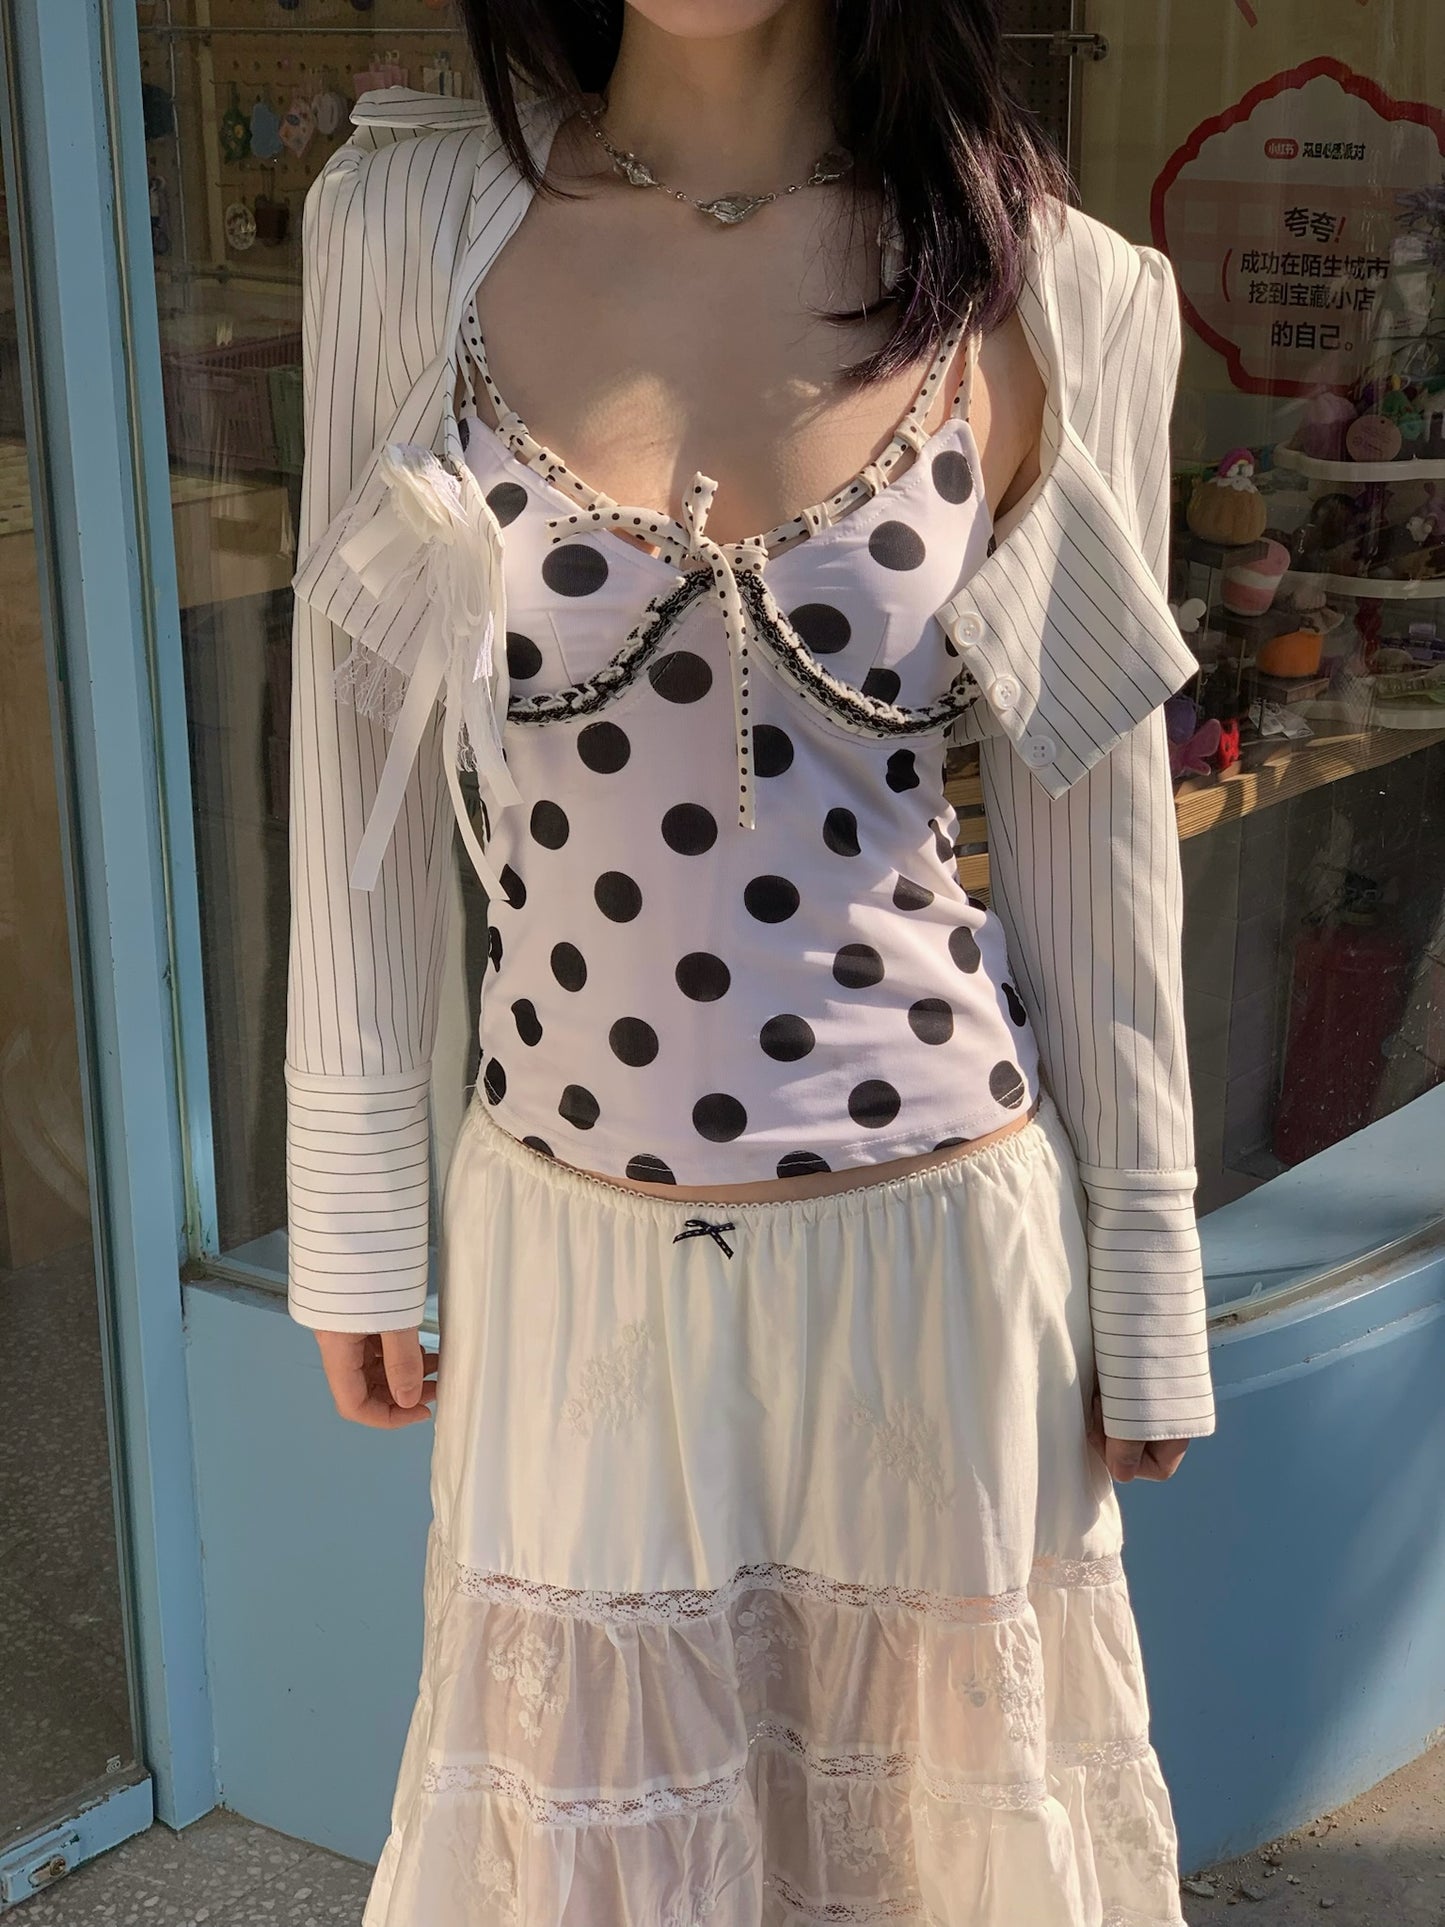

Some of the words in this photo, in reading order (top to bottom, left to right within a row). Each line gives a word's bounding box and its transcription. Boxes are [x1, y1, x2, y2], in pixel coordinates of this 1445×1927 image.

[1240, 249, 1390, 281] 成功在陌生城市
[1248, 280, 1376, 312] 挖到宝藏小店
